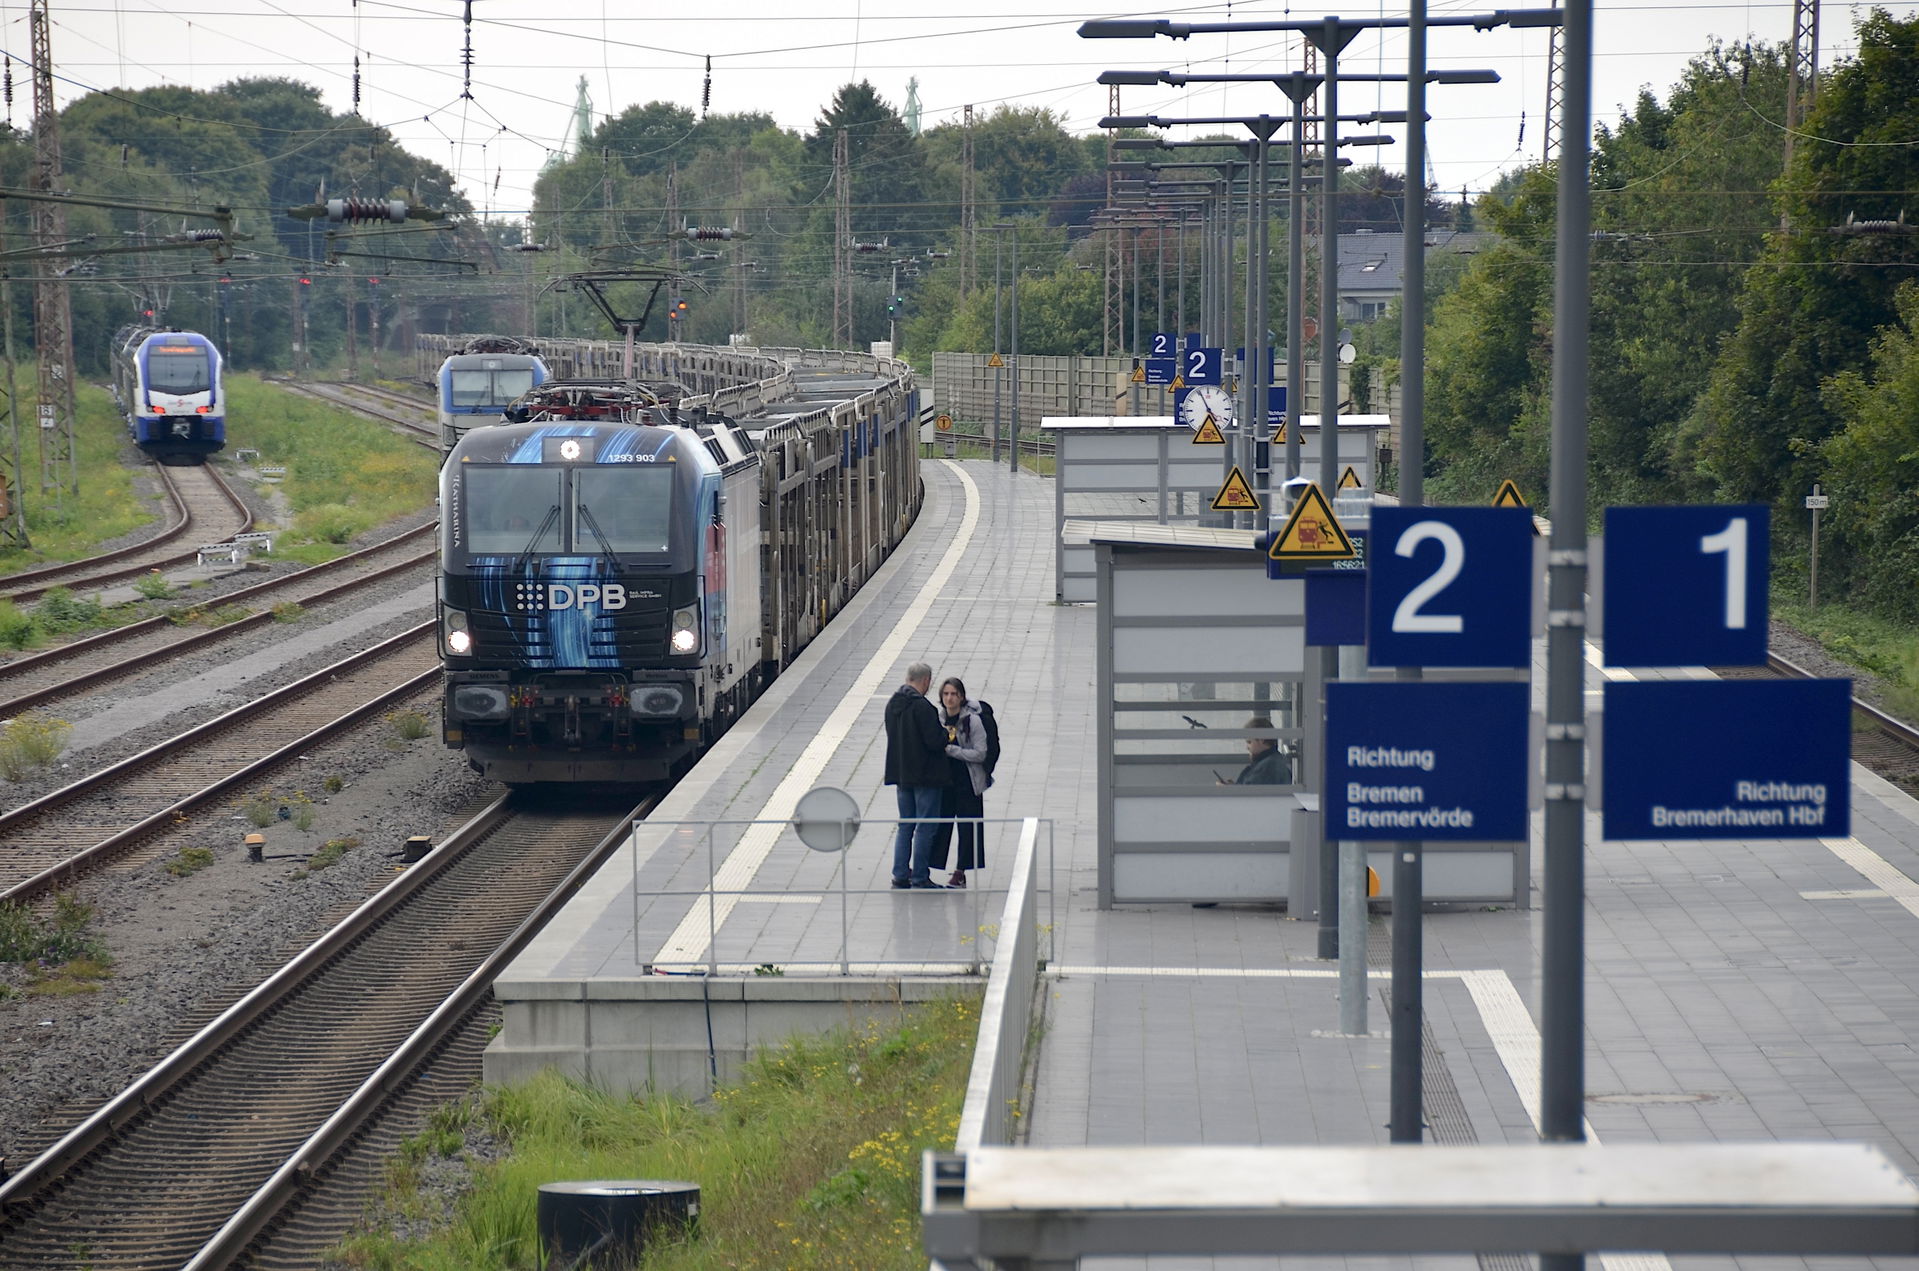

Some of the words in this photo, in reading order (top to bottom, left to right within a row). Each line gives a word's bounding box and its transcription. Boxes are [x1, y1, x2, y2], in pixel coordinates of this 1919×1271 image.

[1154, 335, 1167, 353] 2
[1188, 351, 1206, 378] 2
[609, 454, 633, 462] 1293
[635, 454, 655, 462] 903
[1391, 521, 1465, 633] 2
[1701, 518, 1747, 629] 1
[550, 584, 626, 610] DPB
[1347, 746, 1435, 771] Richtung
[1347, 783, 1423, 803] Bremen
[1737, 781, 1826, 805] Richtung
[1347, 806, 1473, 827] Bremervörde
[1652, 806, 1784, 827] Bremerhaven
[1789, 805, 1825, 825] Hbf
